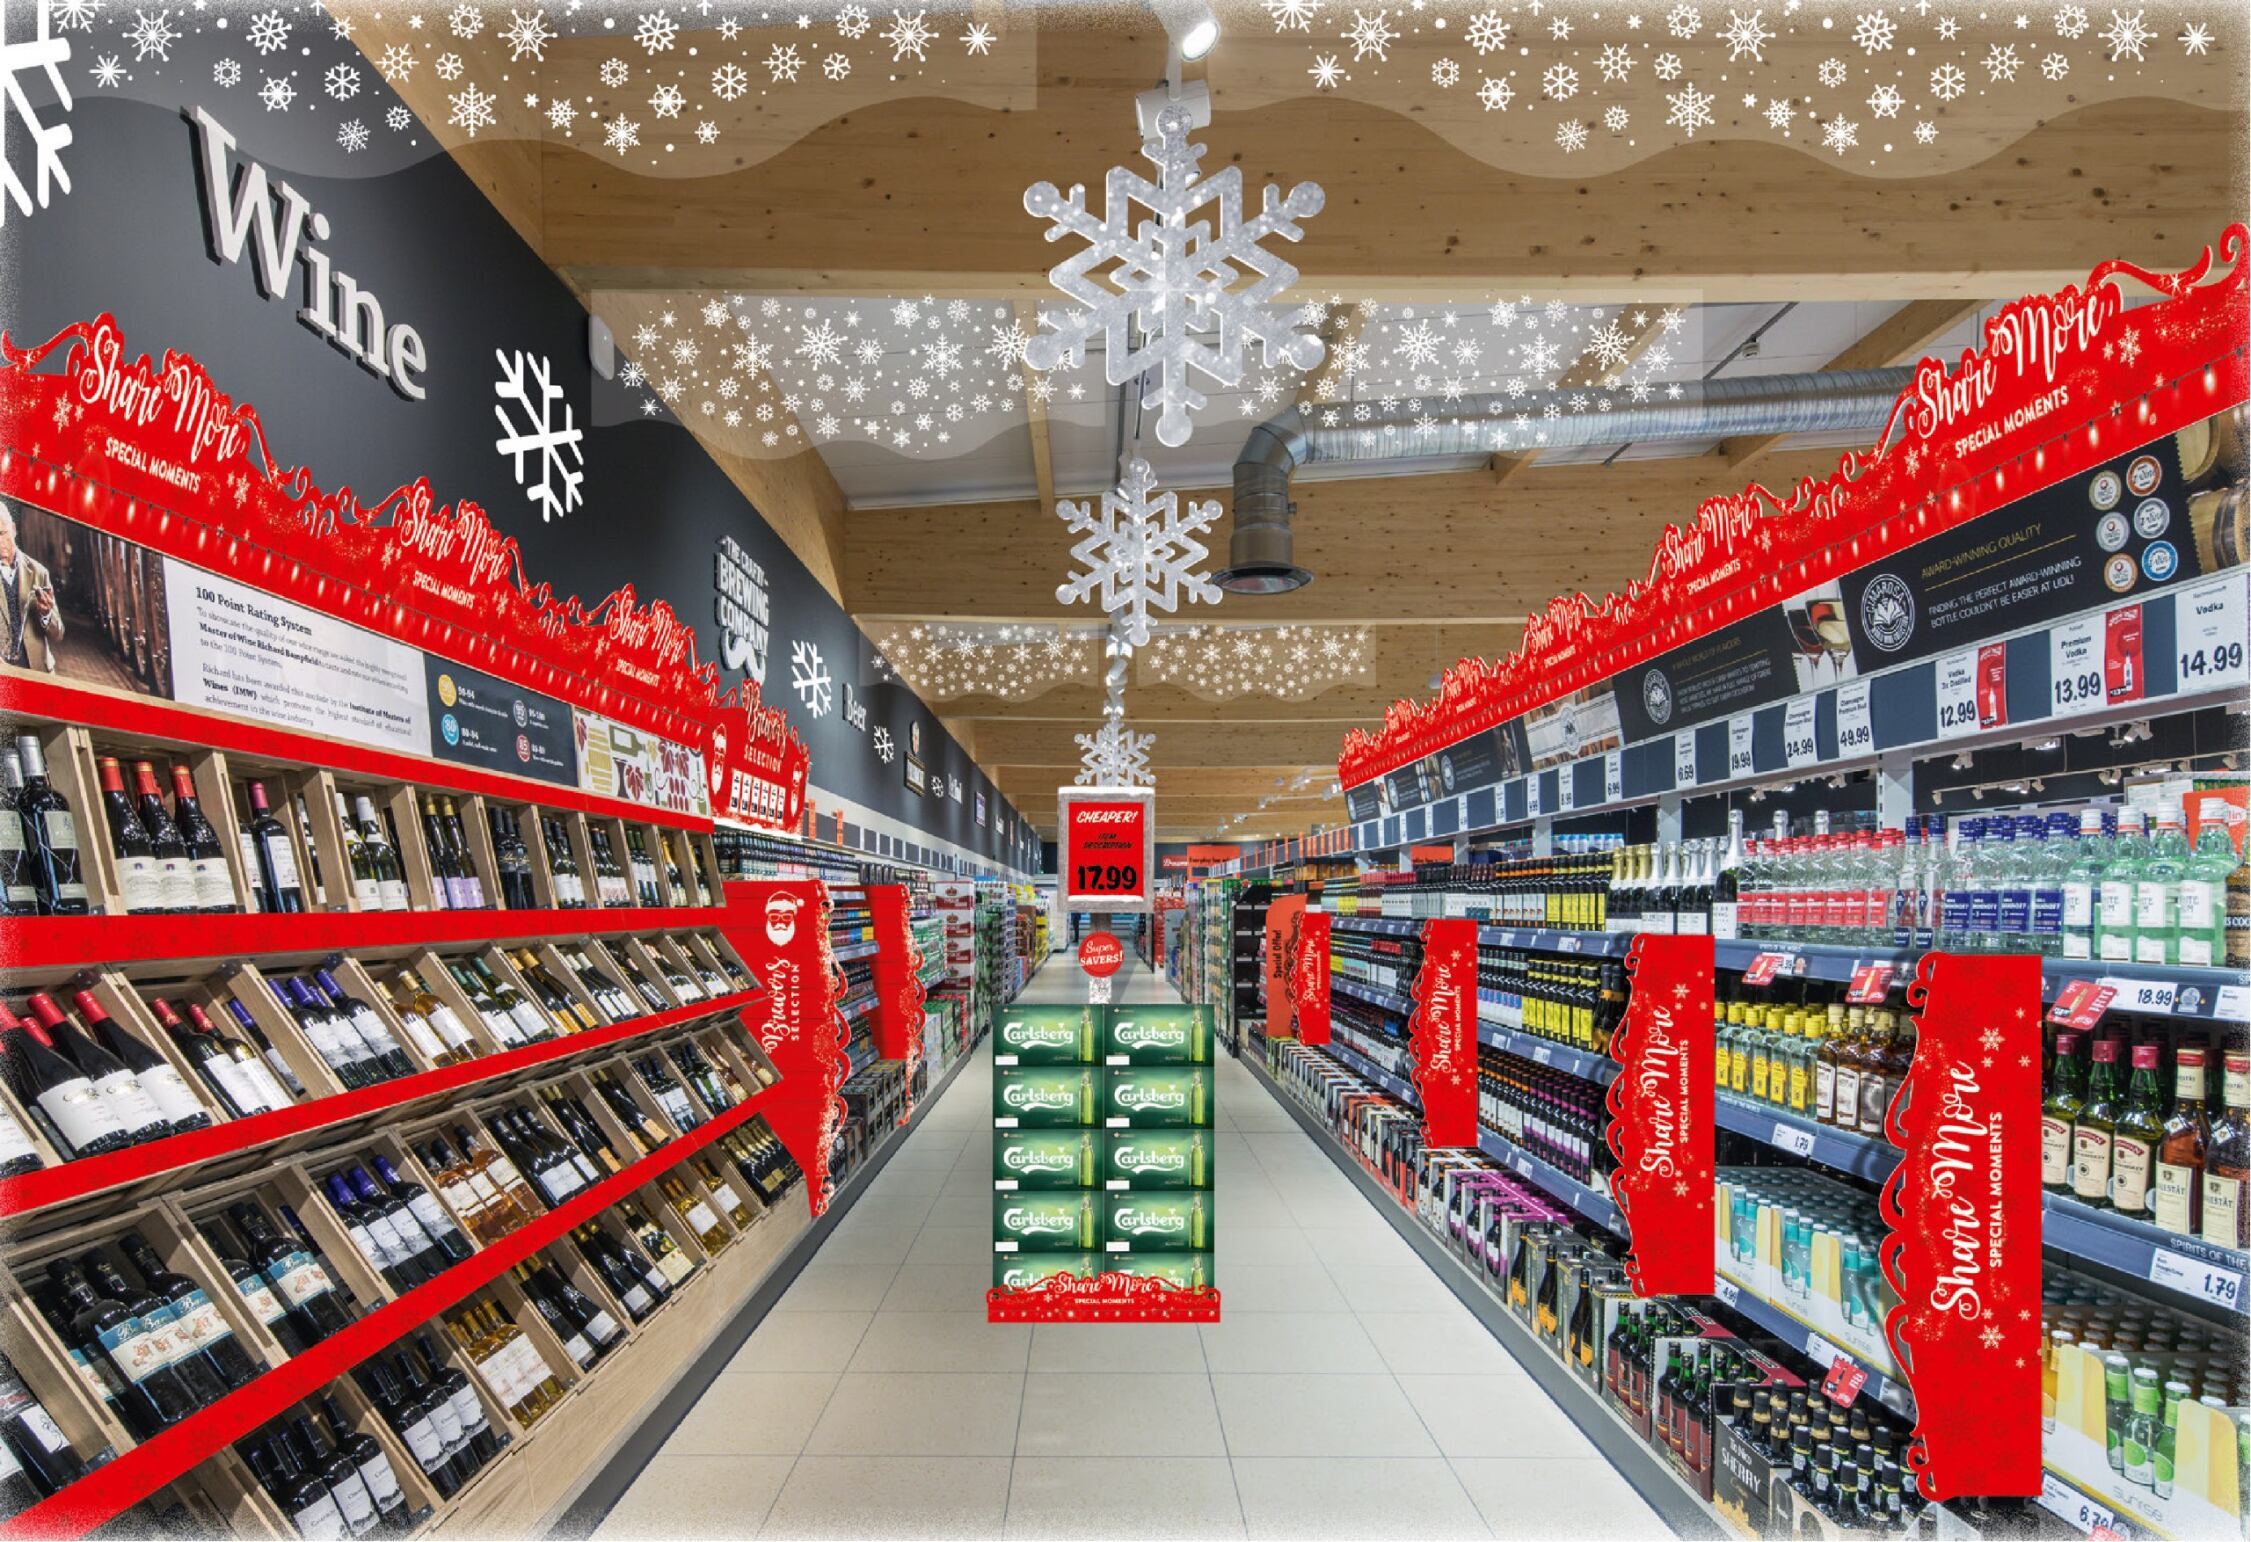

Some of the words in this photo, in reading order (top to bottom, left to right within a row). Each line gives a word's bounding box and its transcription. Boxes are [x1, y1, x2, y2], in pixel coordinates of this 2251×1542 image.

[184, 106, 427, 400] Wine
[1917, 358, 1997, 440] Share
[1990, 294, 2104, 384] More
[79, 324, 165, 428] Share
[163, 363, 248, 463] More
[1955, 429, 2002, 459] SPECIAL
[2003, 385, 2069, 436] MOMENTS
[104, 436, 147, 474] SPECIAL
[148, 457, 202, 495] MOMENTS
[399, 487, 457, 559] Share
[455, 512, 510, 587] More
[1664, 529, 1706, 580] Share
[1701, 502, 1755, 556] More
[1921, 541, 1998, 579] AWARD-WINNING
[1997, 522, 2042, 550] QUALITY
[412, 570, 440, 597] SPECIAL
[441, 582, 475, 610] MOMENTS
[715, 552, 770, 627] BREWING
[1686, 573, 1710, 596] SPECIAL
[1710, 558, 1742, 587] MOMENTS
[1959, 594, 1974, 607] THE
[1975, 582, 2008, 600] PERFECT
[2009, 556, 2082, 590] AWARD-WINNING
[196, 586, 216, 603] 100
[217, 593, 246, 614] Point
[246, 603, 280, 628] Rating
[280, 615, 312, 636] System
[1931, 612, 1959, 629] BOTTLE
[2000, 596, 2011, 607] BE
[2011, 583, 2039, 603] EASIER
[2040, 581, 2051, 593] AT
[2196, 602, 2224, 615] Vodka
[199, 621, 227, 638] Master
[227, 631, 237, 641] of
[236, 633, 257, 647] Wine
[256, 639, 285, 656] Richard
[199, 637, 209, 648] to
[609, 599, 650, 651] Share
[649, 613, 687, 671] More
[2061, 635, 2092, 650] Premium
[2065, 648, 2088, 659] Vodka
[2180, 642, 2243, 679] 14.99
[202, 662, 232, 679] Richard
[231, 669, 245, 682] has
[245, 674, 263, 687] been
[202, 678, 229, 692] Wines
[231, 686, 258, 701] (IMW)
[2054, 671, 2101, 704] 13.99
[204, 694, 249, 712] achievement
[843, 683, 867, 732] Beer
[1940, 700, 1976, 728] 12.99
[1786, 737, 1814, 758] 24.99
[1840, 725, 1870, 747] 49.99
[743, 744, 782, 773] SELECTION
[1731, 750, 1751, 771] 19.99
[1076, 810, 1139, 824] CHEAPER!
[1077, 865, 1138, 891] 17.99
[1079, 949, 1124, 967] SAVERS!
[1085, 940, 1116, 954] Super
[1273, 953, 1283, 979] Special
[791, 963, 801, 1042] SELECTION
[1430, 963, 1454, 1023] More
[1454, 985, 1462, 1022] MOMENTS
[2137, 988, 2172, 1007] 18.99
[1003, 1021, 1074, 1047] Carlsberg
[1114, 1021, 1185, 1047] Carlsberg
[1430, 1019, 1453, 1074] Share
[1454, 1023, 1462, 1052] SPECIAL
[1639, 1005, 1680, 1099] More
[1679, 1038, 1689, 1096] MOMENTS
[1003, 1083, 1074, 1109] Carlsberg
[1114, 1083, 1185, 1109] Carlsberg
[1639, 1094, 1675, 1179] Share
[1679, 1097, 1689, 1144] SPECIAL
[1930, 1060, 1989, 1200] More
[1003, 1146, 1074, 1172] Carlsberg
[1114, 1146, 1185, 1172] Carlsberg
[1988, 1111, 2003, 1197] MOMENTS
[1003, 1208, 1074, 1234] Carlsberg
[1114, 1208, 1185, 1234] Carlsberg
[1988, 1200, 2003, 1269] SPECIAL
[1930, 1196, 1982, 1322] Share
[2170, 1238, 2207, 1258] SPIRITS
[2208, 1250, 2224, 1261] OF
[2225, 1254, 2248, 1271] THE
[1055, 1273, 1101, 1296] Share
[1099, 1273, 1155, 1297] More
[2204, 1273, 2236, 1300] 1.79
[1721, 1446, 1761, 1495] SHERRY
